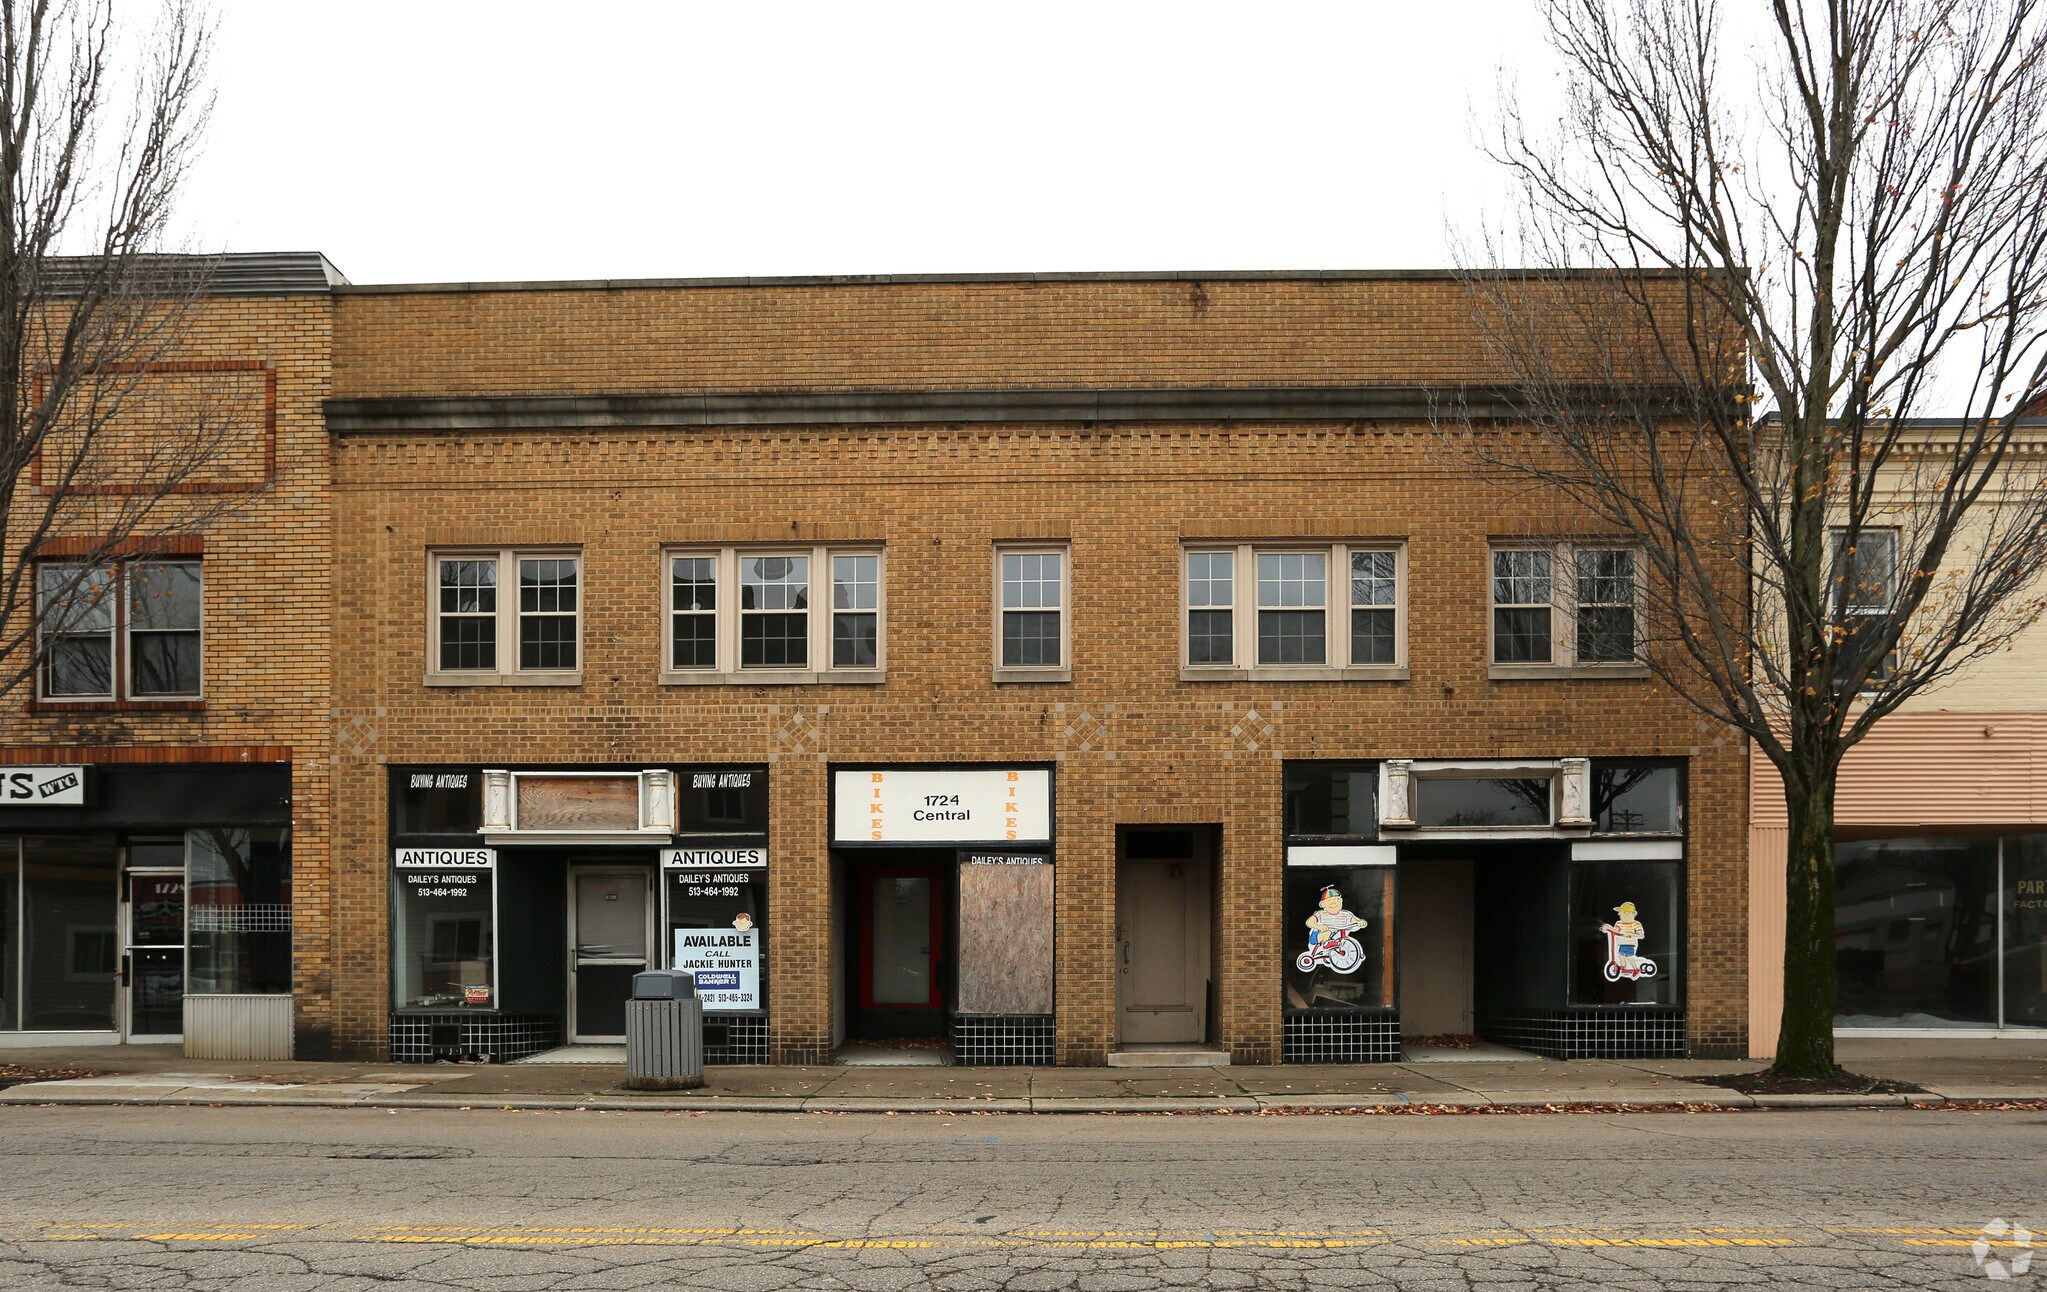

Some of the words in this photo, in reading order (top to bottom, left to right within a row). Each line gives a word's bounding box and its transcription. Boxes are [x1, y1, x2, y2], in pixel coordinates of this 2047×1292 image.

[0, 773, 34, 799] S
[40, 774, 77, 796] WTC
[410, 774, 434, 789] BUYING
[435, 774, 468, 789] ANTIQUES
[692, 774, 716, 789] BUYING
[718, 773, 751, 788] ANTIQUES
[923, 795, 960, 806] 1724
[1005, 771, 1019, 840] BIKES
[870, 773, 884, 841] BIKES
[913, 810, 970, 821] Central
[401, 851, 488, 865] ANTIQUES
[671, 850, 759, 865] ANTIQUES
[408, 875, 439, 884] DAILEY'S
[441, 875, 477, 884] ANTIQUES
[679, 874, 711, 884] DAILEY'S
[712, 873, 749, 883] ANTIQUES
[418, 888, 467, 897] 513-464-1992
[688, 886, 739, 897] 513-464-1992
[683, 935, 751, 947] AVAILABLE
[705, 950, 731, 958] CALL
[683, 960, 714, 969] JACKIE
[718, 959, 752, 968] HUNTER
